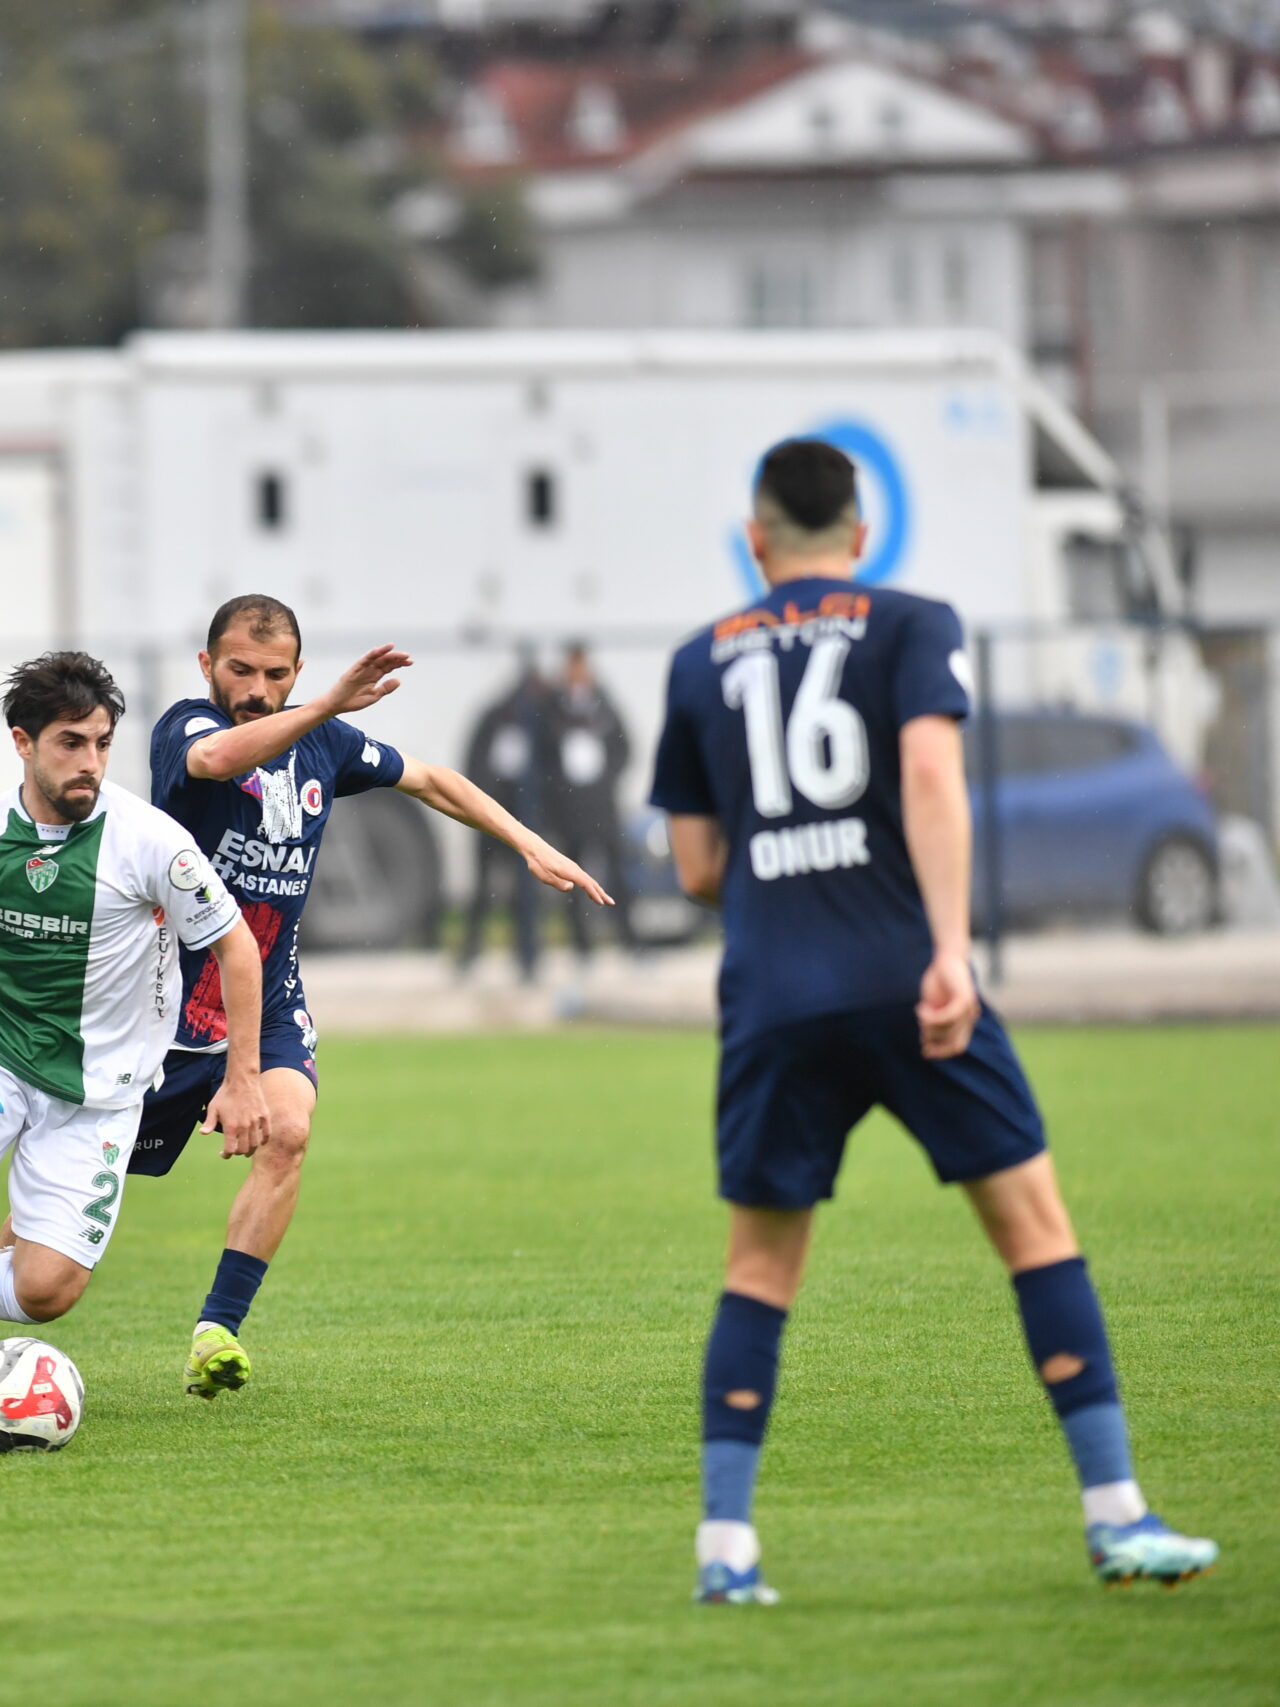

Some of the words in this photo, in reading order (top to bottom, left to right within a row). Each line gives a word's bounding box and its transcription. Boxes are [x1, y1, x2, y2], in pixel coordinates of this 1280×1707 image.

[721, 636, 870, 818] 16
[211, 853, 308, 896] HASTANES
[750, 817, 870, 880] ONUR
[81, 1170, 119, 1227] 2
